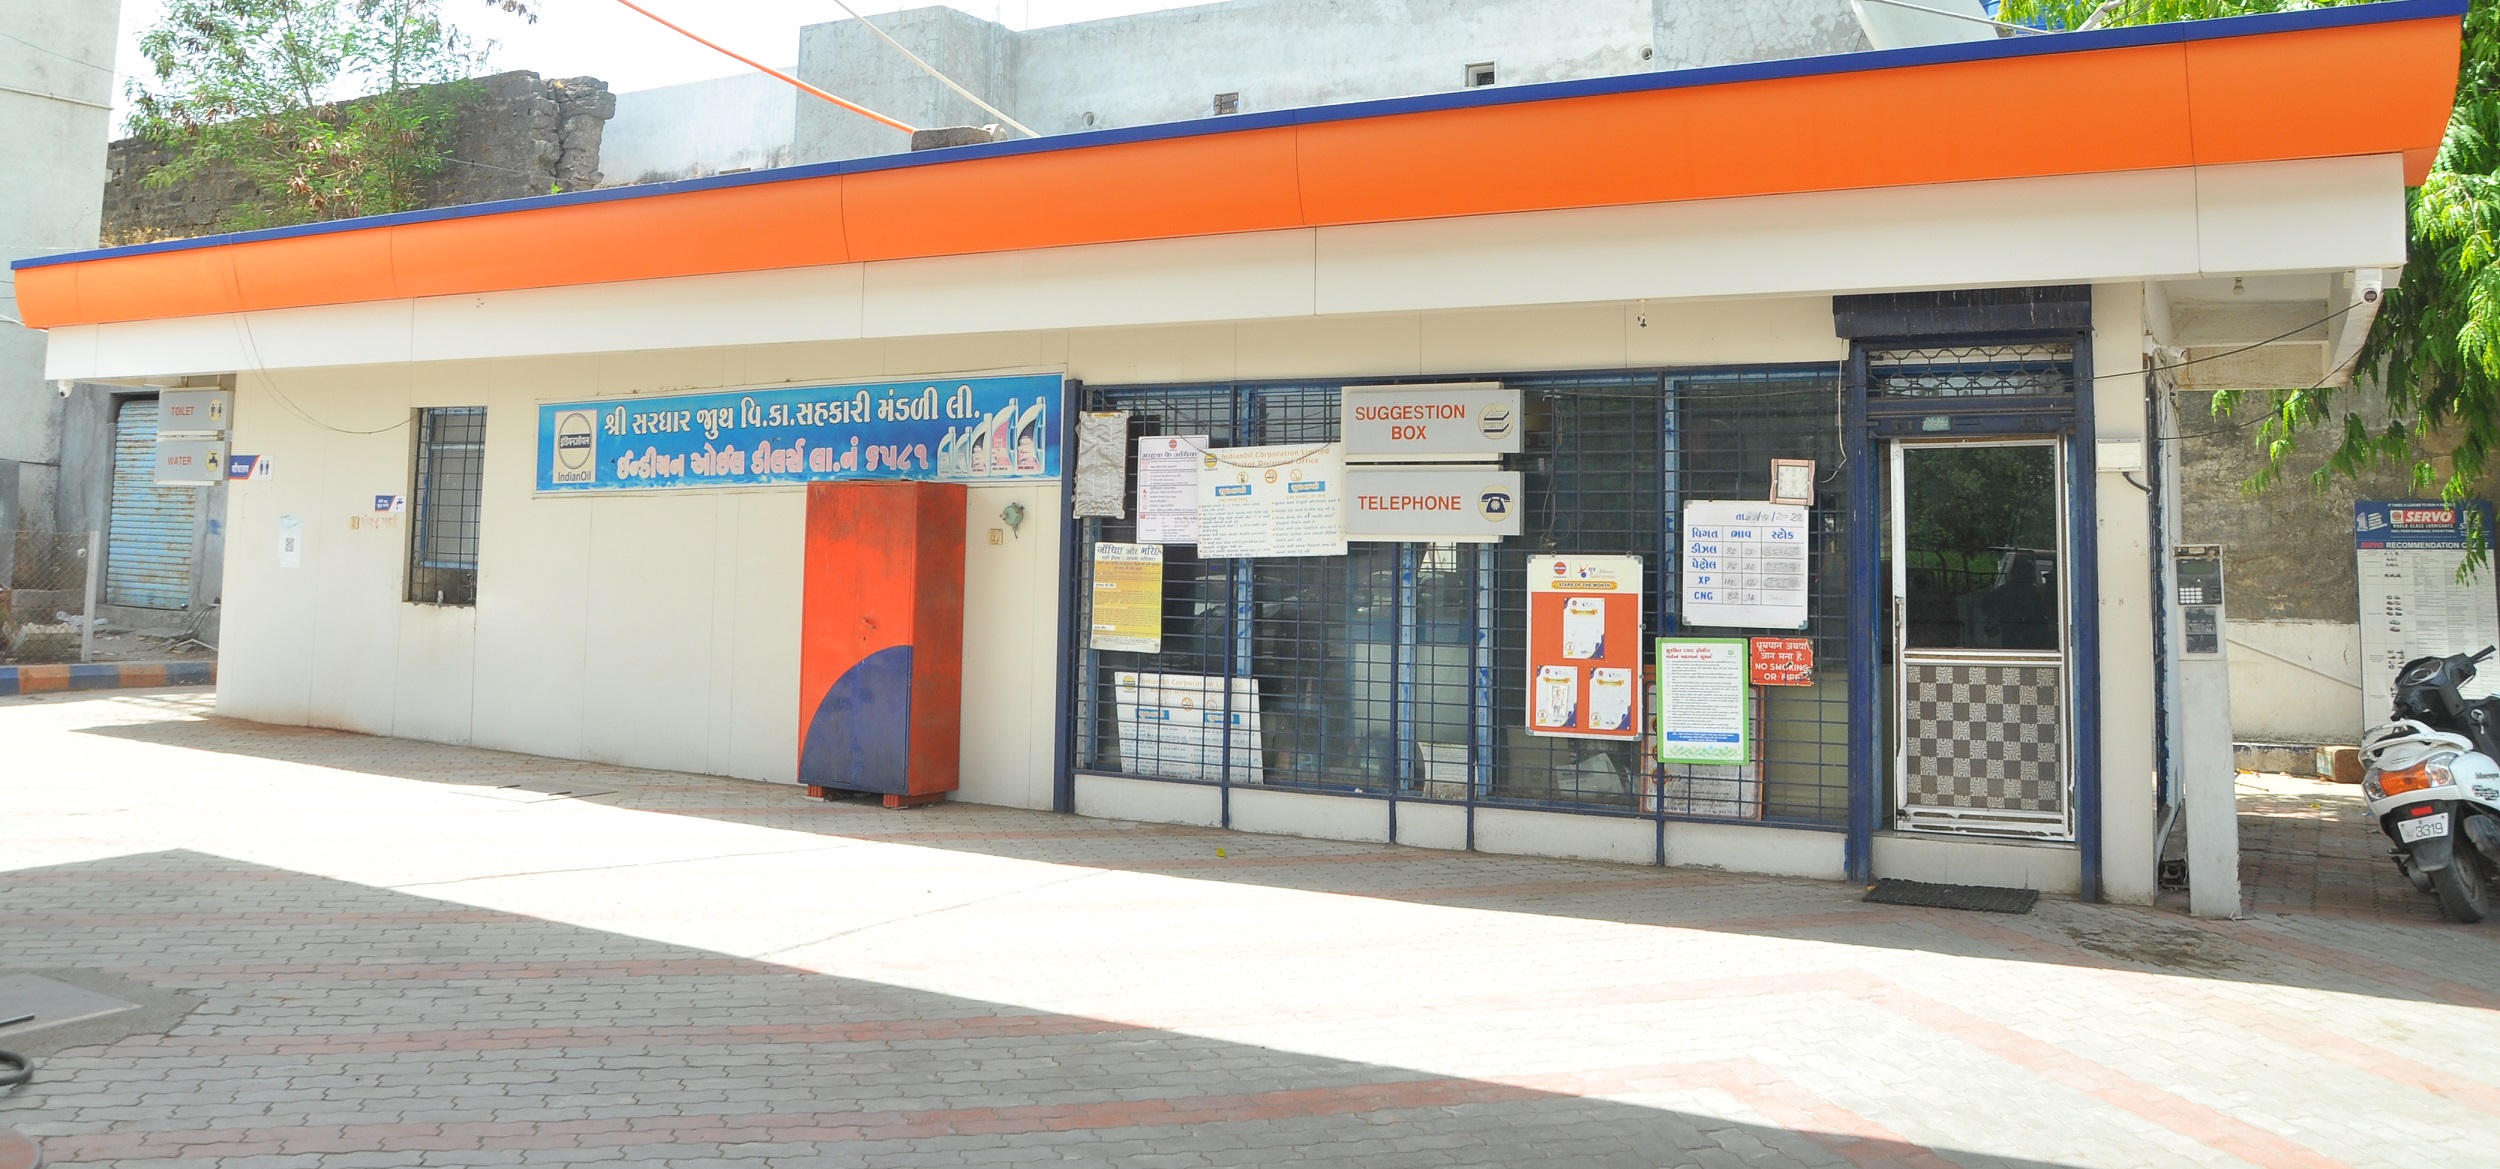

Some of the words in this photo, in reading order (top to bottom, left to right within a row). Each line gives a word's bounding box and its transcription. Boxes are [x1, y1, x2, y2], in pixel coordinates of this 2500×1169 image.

[171, 406, 195, 416] TOILET
[604, 405, 627, 436] શ્રી
[631, 410, 691, 434] સરધાર
[877, 386, 940, 422] મંડળી
[1355, 404, 1466, 421] SUGGESTION
[1391, 425, 1427, 441] BOX
[616, 446, 685, 480] ઈન્ડીયન
[690, 442, 745, 477] ઓઈલ
[750, 438, 806, 474] ડીલર્સ
[1221, 452, 1253, 460] IndianOil
[1255, 449, 1299, 460] Corporation
[1301, 447, 1330, 456] Limited
[168, 456, 192, 466] WATER
[1257, 459, 1293, 468] Divisional
[1296, 457, 1319, 465] Office
[558, 471, 592, 482] IndianOil
[1357, 495, 1462, 511] TELEPHONE
[2405, 510, 2452, 523] SERVO
[1691, 527, 1718, 539] વિગત
[1730, 530, 1752, 539] ભાવ
[1771, 528, 1794, 540] સ્ટોક
[1691, 543, 1717, 554] ડીઝલ
[2361, 541, 2385, 549] SERVO
[2386, 541, 2460, 549] RECOMMENDATION
[1692, 557, 1717, 571] પેટ્રોલ
[1698, 576, 1710, 585] XP
[1694, 591, 1713, 601] CNG
[1755, 662, 1768, 670] NO
[1769, 663, 1809, 672] SMOKING
[2414, 822, 2444, 838] 3319
